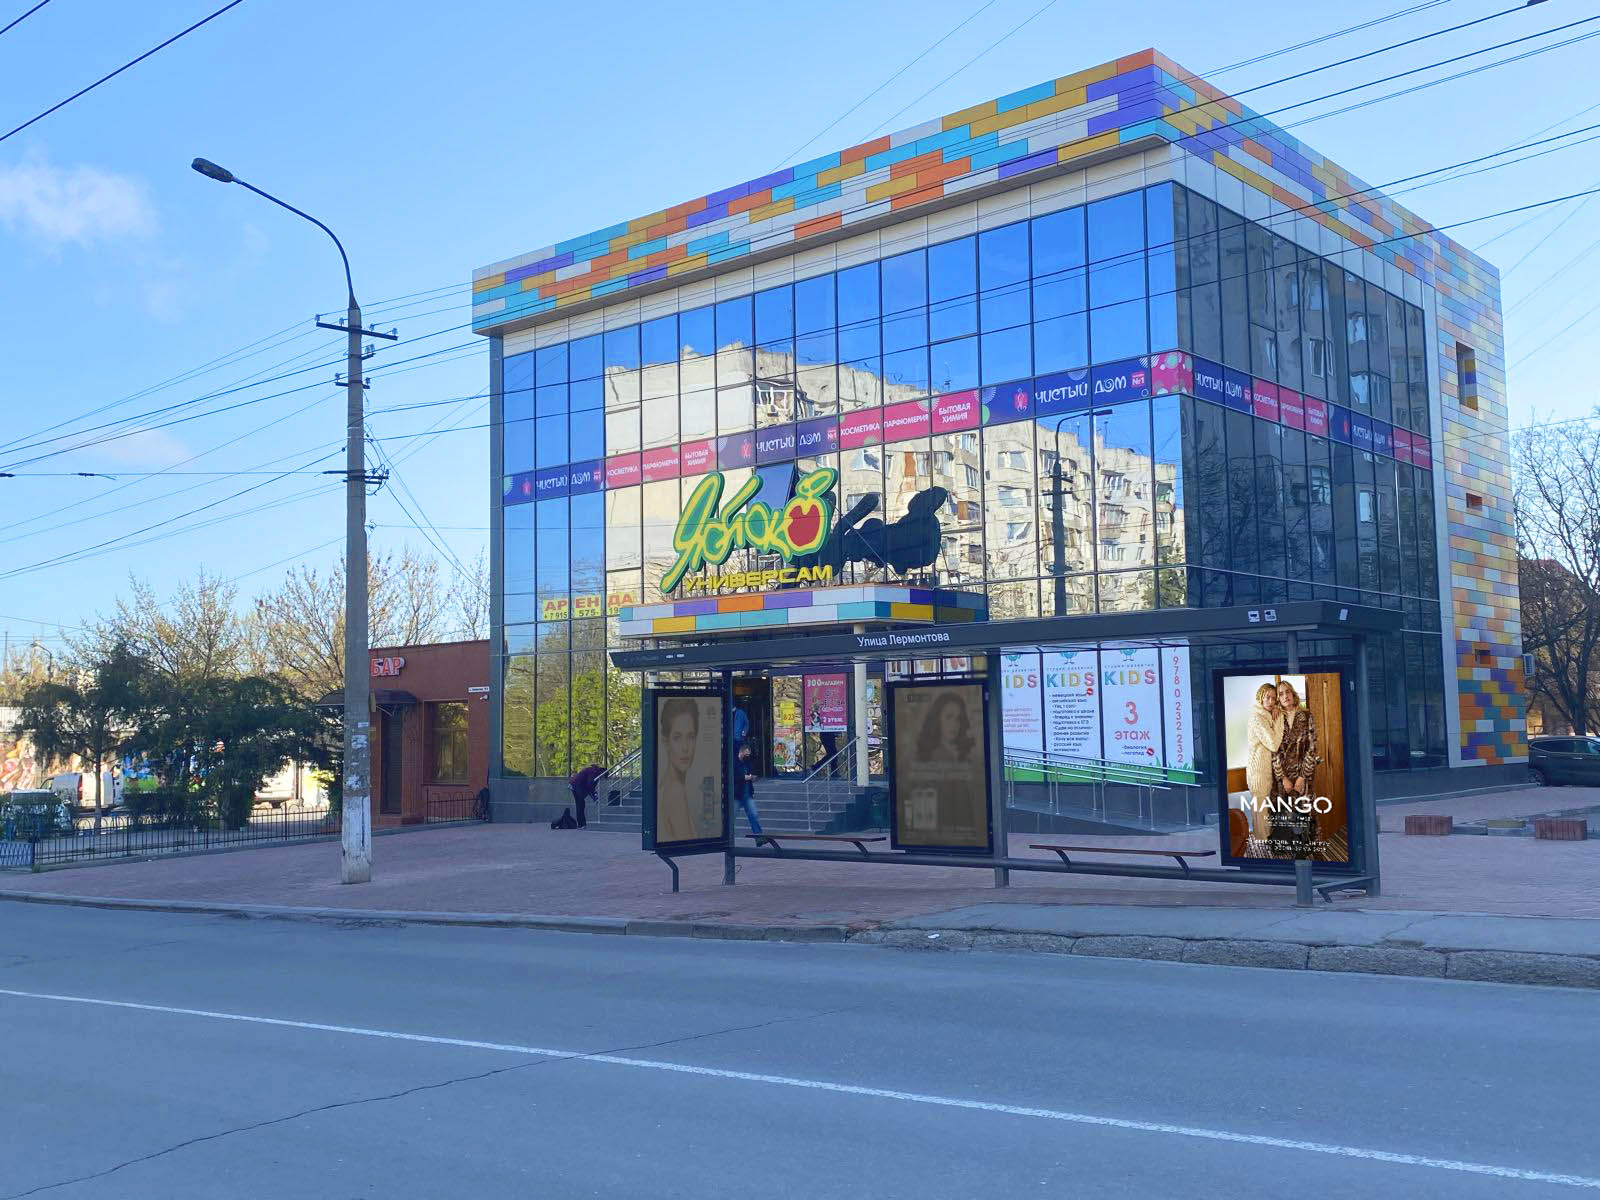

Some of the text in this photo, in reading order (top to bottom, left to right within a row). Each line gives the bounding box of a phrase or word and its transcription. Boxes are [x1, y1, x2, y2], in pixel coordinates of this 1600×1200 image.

[1034, 381, 1088, 403] ЧИСТЫЙ
[1094, 375, 1127, 394] ДОМ
[1195, 372, 1224, 393] ЧИСТЫЙ
[1225, 381, 1242, 398] ДОМ
[938, 403, 971, 415] БЫТОВАЯ
[941, 411, 968, 424] ХИМИЯ
[840, 422, 880, 436] КОСМЕТИКА
[883, 413, 929, 428] ПАРФЮМЕРИЯ
[756, 433, 795, 453] ЧИСТЫЙ
[799, 431, 821, 446] ДОМ
[606, 465, 640, 478] КОСМЕТИКА
[536, 473, 568, 490] ЧИСТЫЙ
[570, 471, 591, 486] ДОМ
[683, 564, 833, 592] УНИВЕРСАМ
[857, 632, 950, 647] Улица Лермонтова
[370, 657, 405, 677] БАР
[1046, 671, 1095, 688] KIDS
[1103, 669, 1156, 686] KIDS
[1124, 701, 1139, 725] 3
[1114, 730, 1150, 741] этаж
[1239, 795, 1333, 814] MANGO
